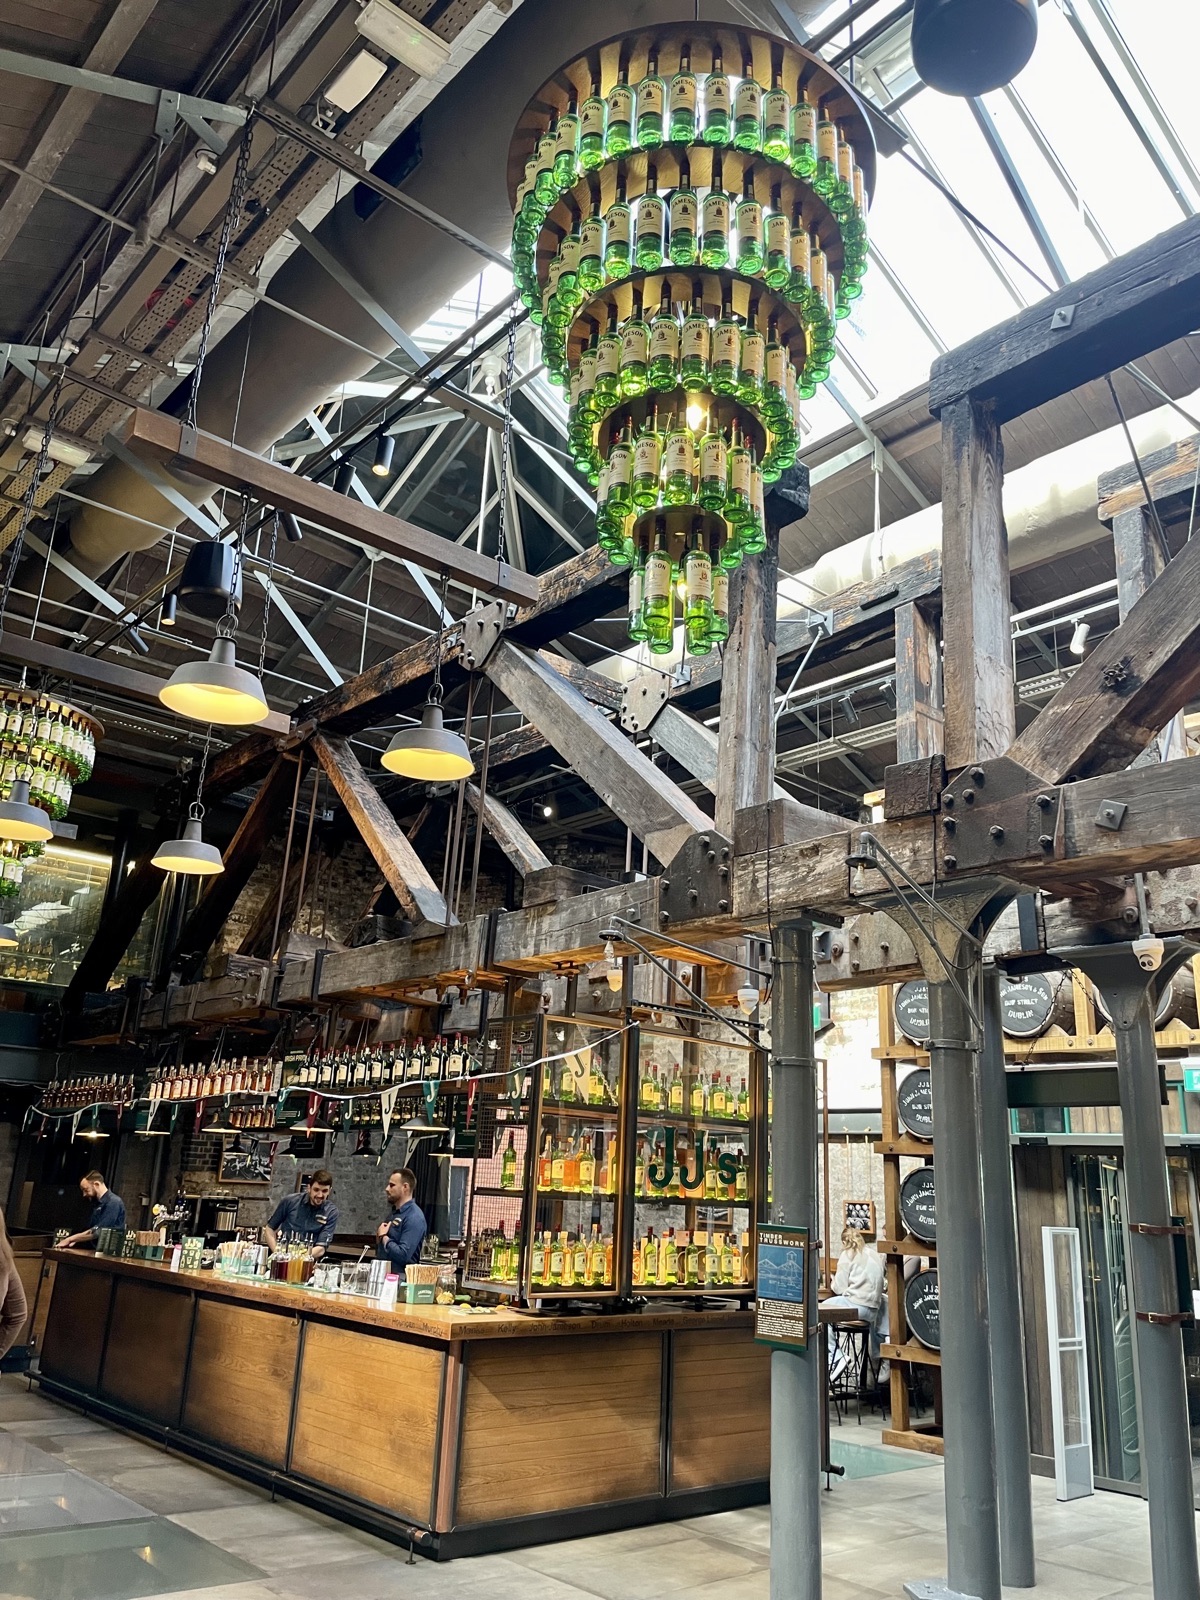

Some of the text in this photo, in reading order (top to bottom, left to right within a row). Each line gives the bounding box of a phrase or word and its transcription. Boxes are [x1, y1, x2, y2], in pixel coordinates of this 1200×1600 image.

[1008, 1009, 1034, 1019] DUBLIN
[426, 1081, 436, 1103] J
[468, 1081, 476, 1106] J
[510, 1073, 520, 1099] J
[309, 1095, 318, 1115] J
[345, 1098, 353, 1120] J
[384, 1094, 392, 1115] J
[648, 1126, 738, 1190] JJ's
[759, 1232, 783, 1240] TIMBER
[759, 1237, 805, 1247] TRUSSWORK
[497, 1322, 517, 1334] Kelly
